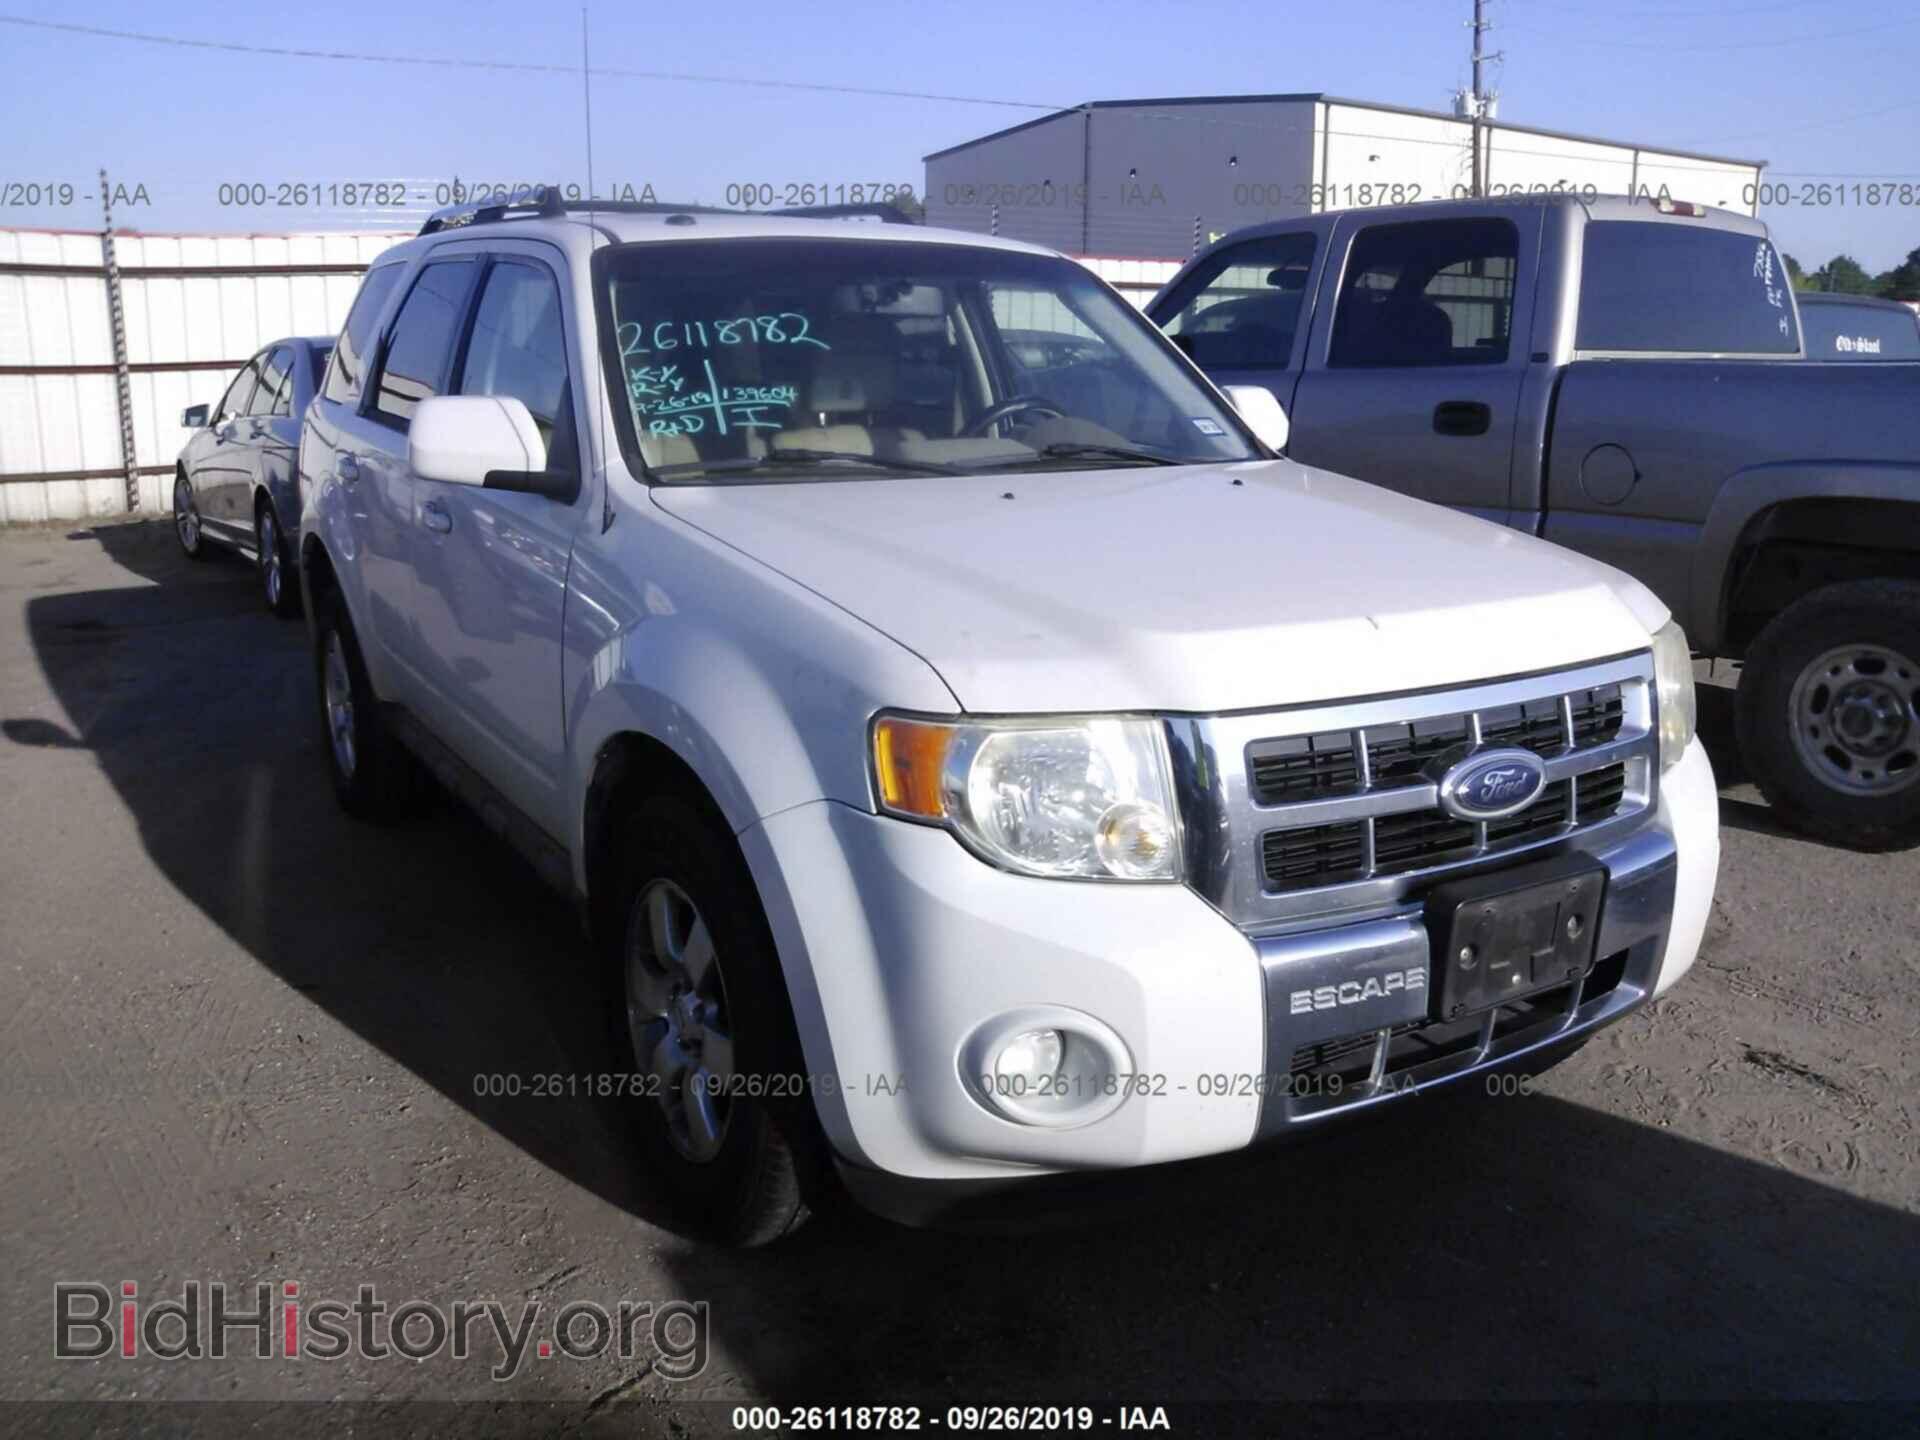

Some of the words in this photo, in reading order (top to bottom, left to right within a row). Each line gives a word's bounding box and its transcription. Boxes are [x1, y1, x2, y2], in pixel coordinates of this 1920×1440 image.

[616, 312, 832, 355] 26118782
[1481, 768, 1528, 800] Ford
[1290, 967, 1426, 1015] ESCAPE
